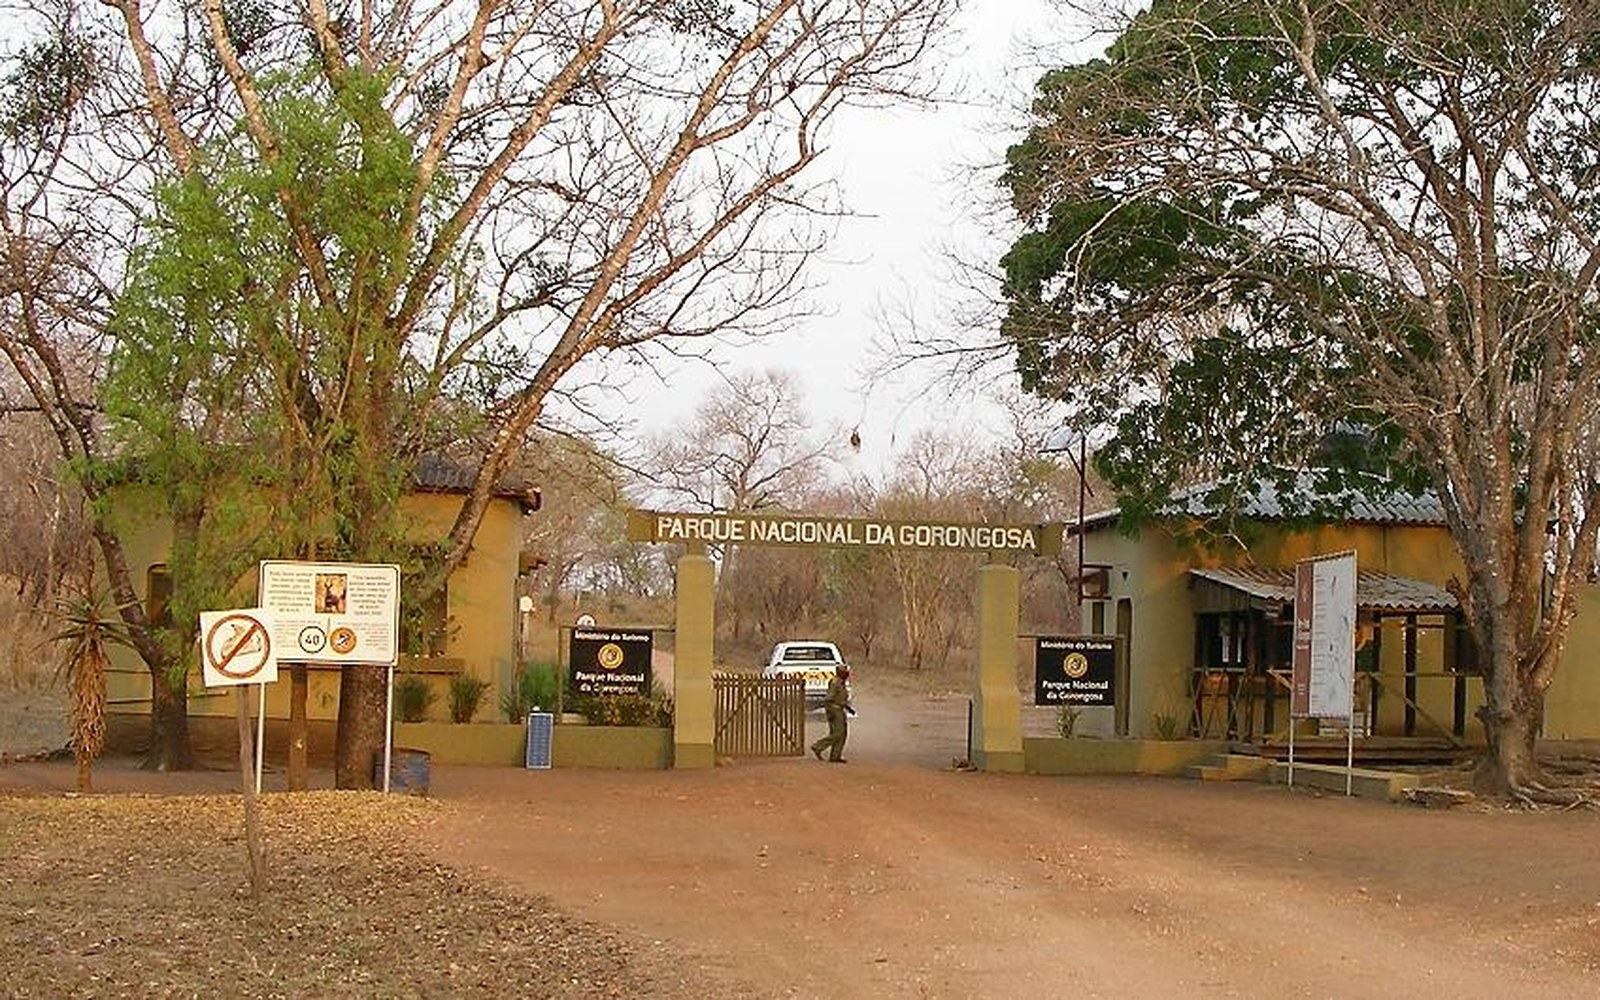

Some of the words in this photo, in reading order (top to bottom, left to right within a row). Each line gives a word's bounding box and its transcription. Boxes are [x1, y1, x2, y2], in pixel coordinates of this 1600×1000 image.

[658, 517, 746, 541] PARQUE
[749, 519, 861, 545] NACIONAL
[865, 523, 894, 547] DA
[899, 523, 1037, 550] GORONGOSA
[305, 635, 319, 646] 40
[622, 633, 650, 642] Turismo
[1086, 642, 1113, 650] Turismo
[576, 671, 606, 682] Parque
[607, 673, 645, 682] Nacional
[580, 683, 591, 691] da
[1042, 681, 1071, 691] Parque
[1072, 681, 1109, 690] Nacional
[1059, 692, 1104, 703] Gorongosa
